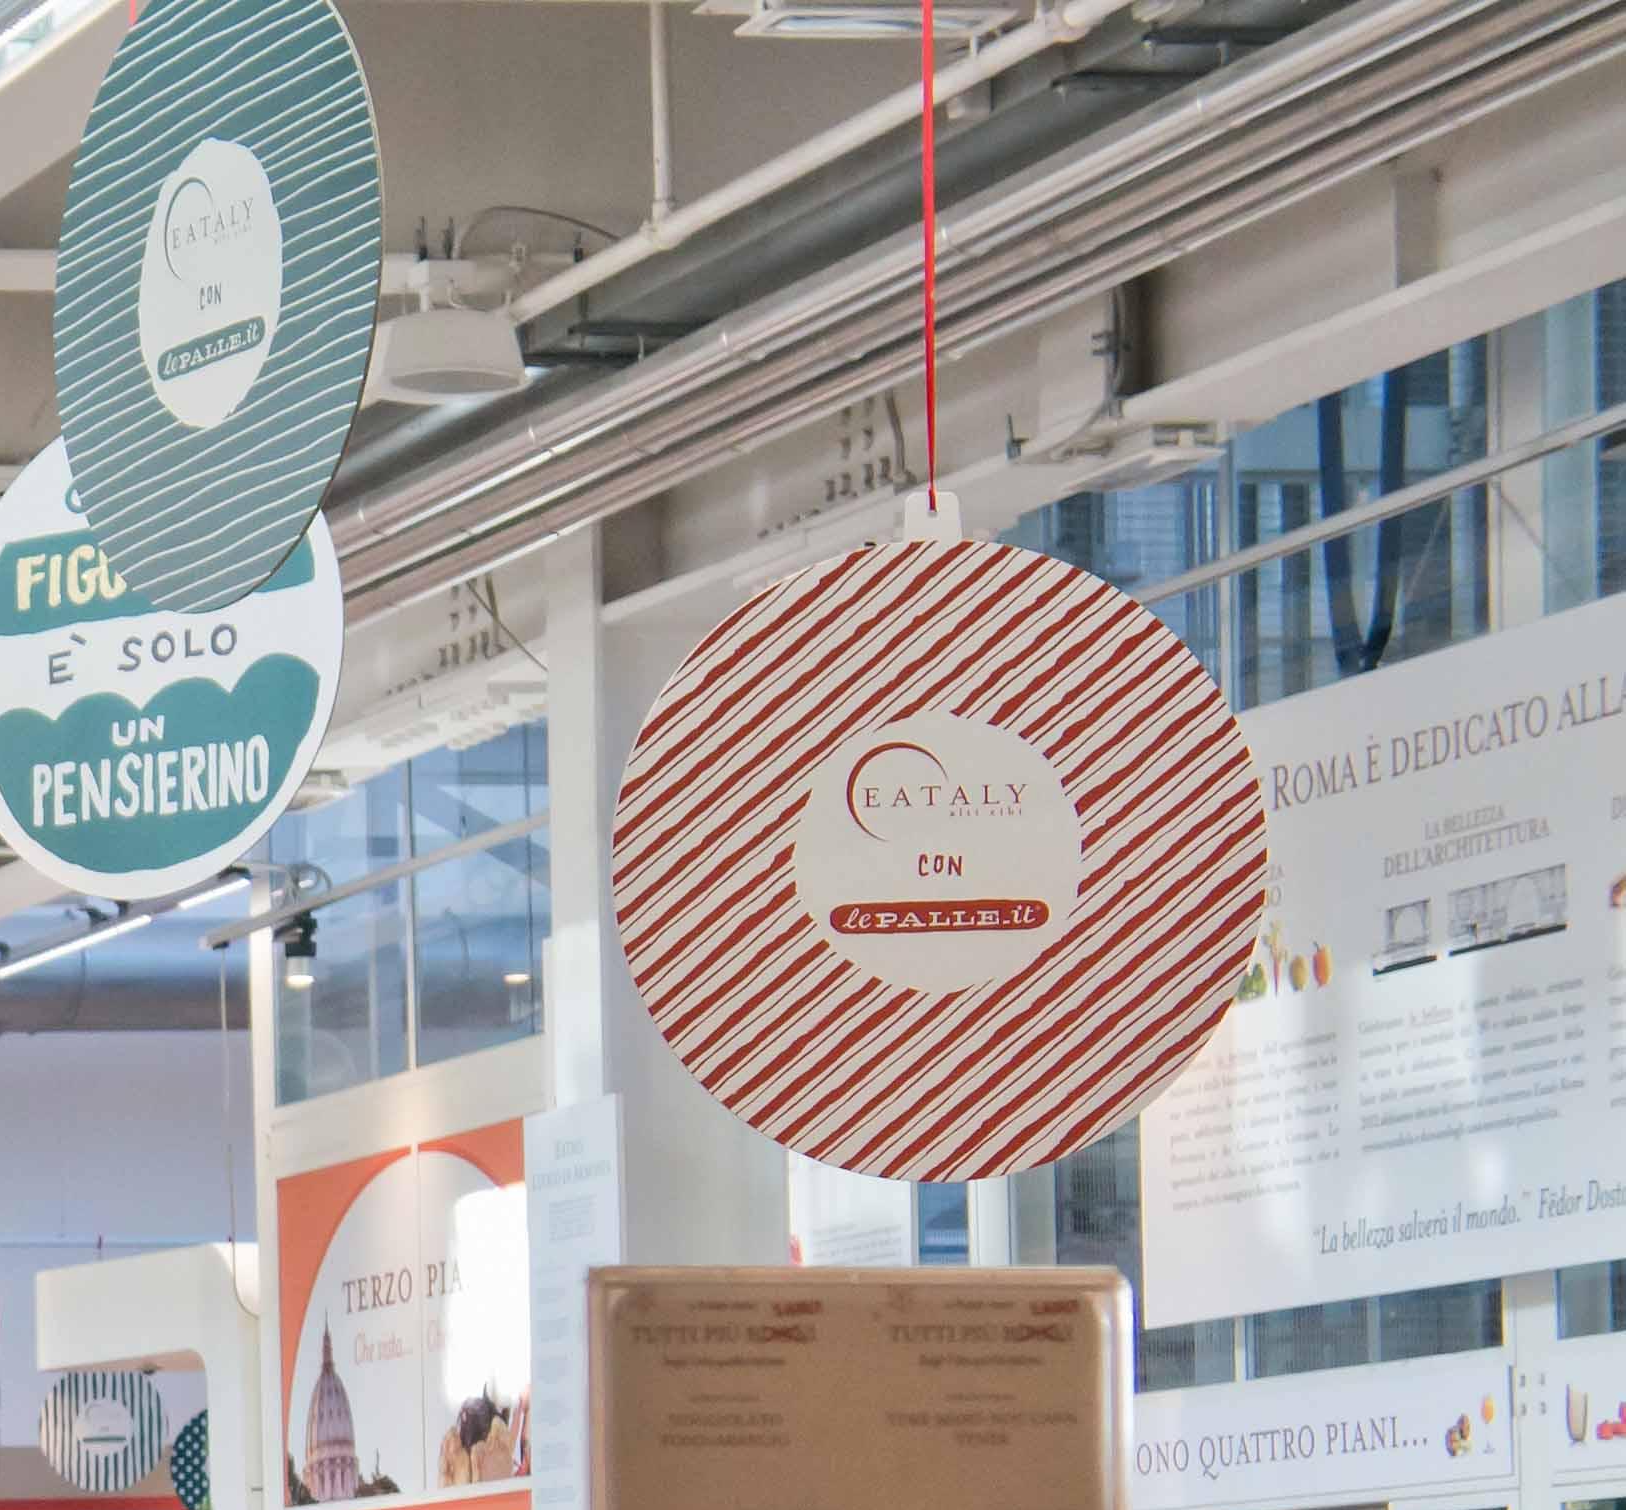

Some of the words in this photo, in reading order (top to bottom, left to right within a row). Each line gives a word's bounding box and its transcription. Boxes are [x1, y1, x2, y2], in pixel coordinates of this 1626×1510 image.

[172, 198, 253, 249] EATALY
[200, 283, 222, 310] CON
[117, 623, 238, 672] SOLO
[111, 715, 165, 748] UN
[1272, 751, 1358, 812] ROMA
[1390, 694, 1549, 779] DEDICATO
[33, 734, 270, 828] PENSIERINO
[861, 783, 1029, 809] EATALY
[917, 852, 964, 877] CON
[1383, 817, 1550, 879] DELL'ARCHITETTURA
[842, 903, 1037, 929] lePALLE.it
[342, 1267, 414, 1316] TERZO
[1135, 1440, 1190, 1476] ONO
[1198, 1424, 1316, 1480] QUATTRO
